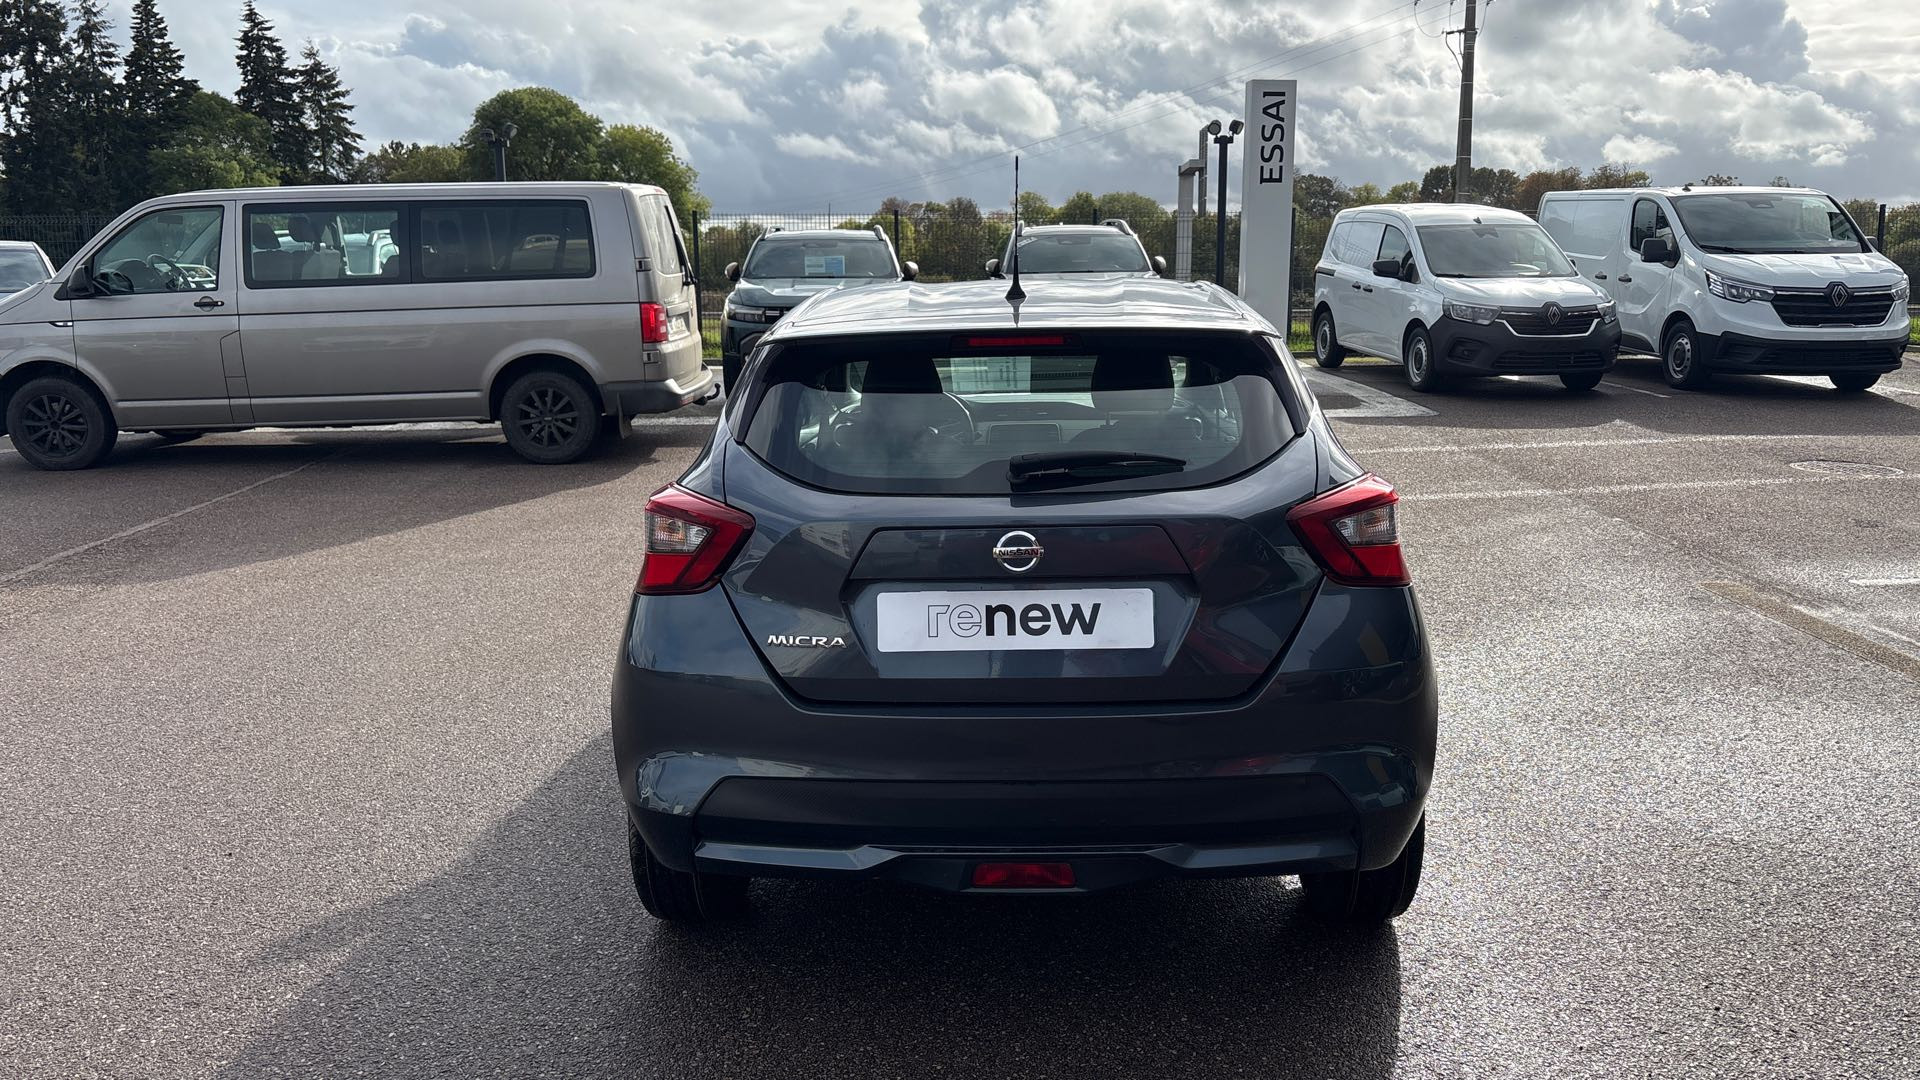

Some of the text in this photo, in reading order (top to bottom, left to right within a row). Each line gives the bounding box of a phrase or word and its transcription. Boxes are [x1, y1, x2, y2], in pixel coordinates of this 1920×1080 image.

[1260, 91, 1286, 184] ESSAI
[998, 548, 1039, 557] NISSAN
[927, 603, 1101, 638] renew
[767, 634, 847, 649] MICRA
